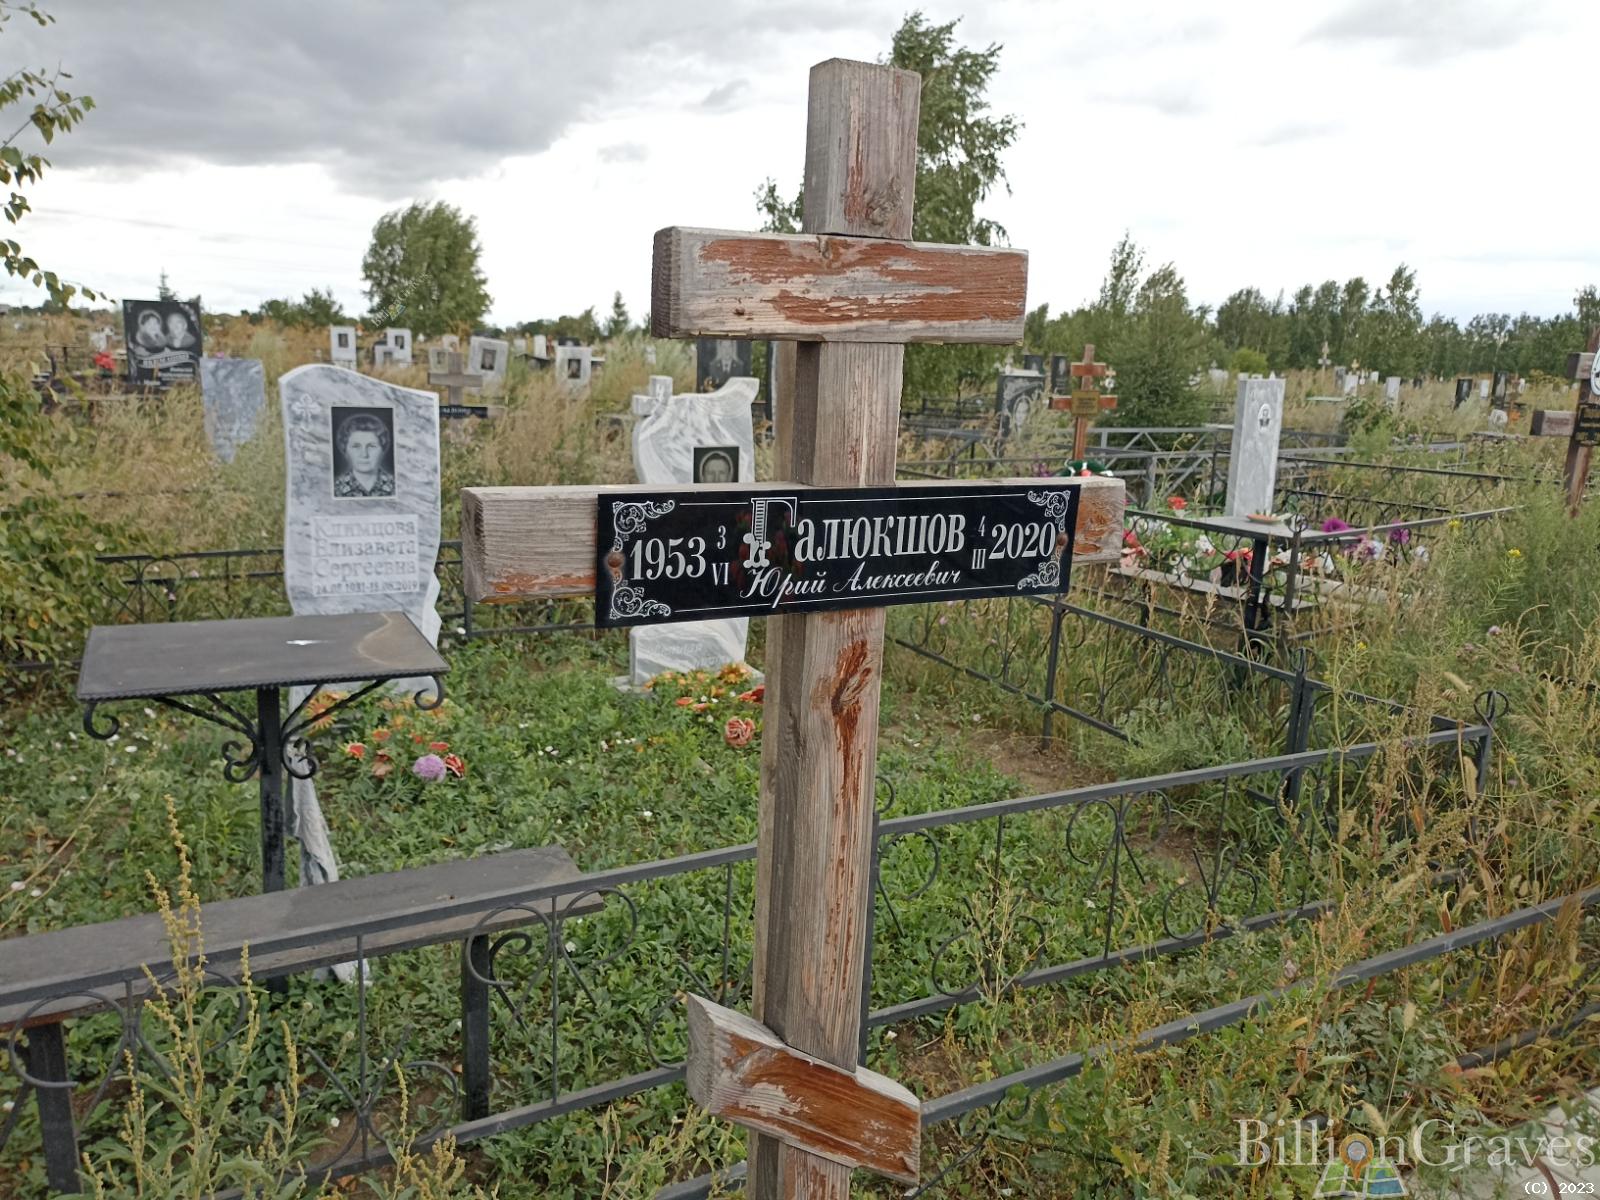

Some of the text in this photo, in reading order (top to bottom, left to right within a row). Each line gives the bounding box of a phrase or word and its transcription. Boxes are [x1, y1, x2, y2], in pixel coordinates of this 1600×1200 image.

[717, 525, 727, 550] 3
[978, 515, 986, 537] 4
[313, 538, 417, 557] Елизавета
[988, 522, 1056, 560] 2020
[314, 558, 417, 582] Сергеевна
[630, 536, 706, 580] 1953
[971, 548, 986, 570] III
[711, 562, 731, 587] VI
[740, 561, 961, 609] Юрий Алексеевич
